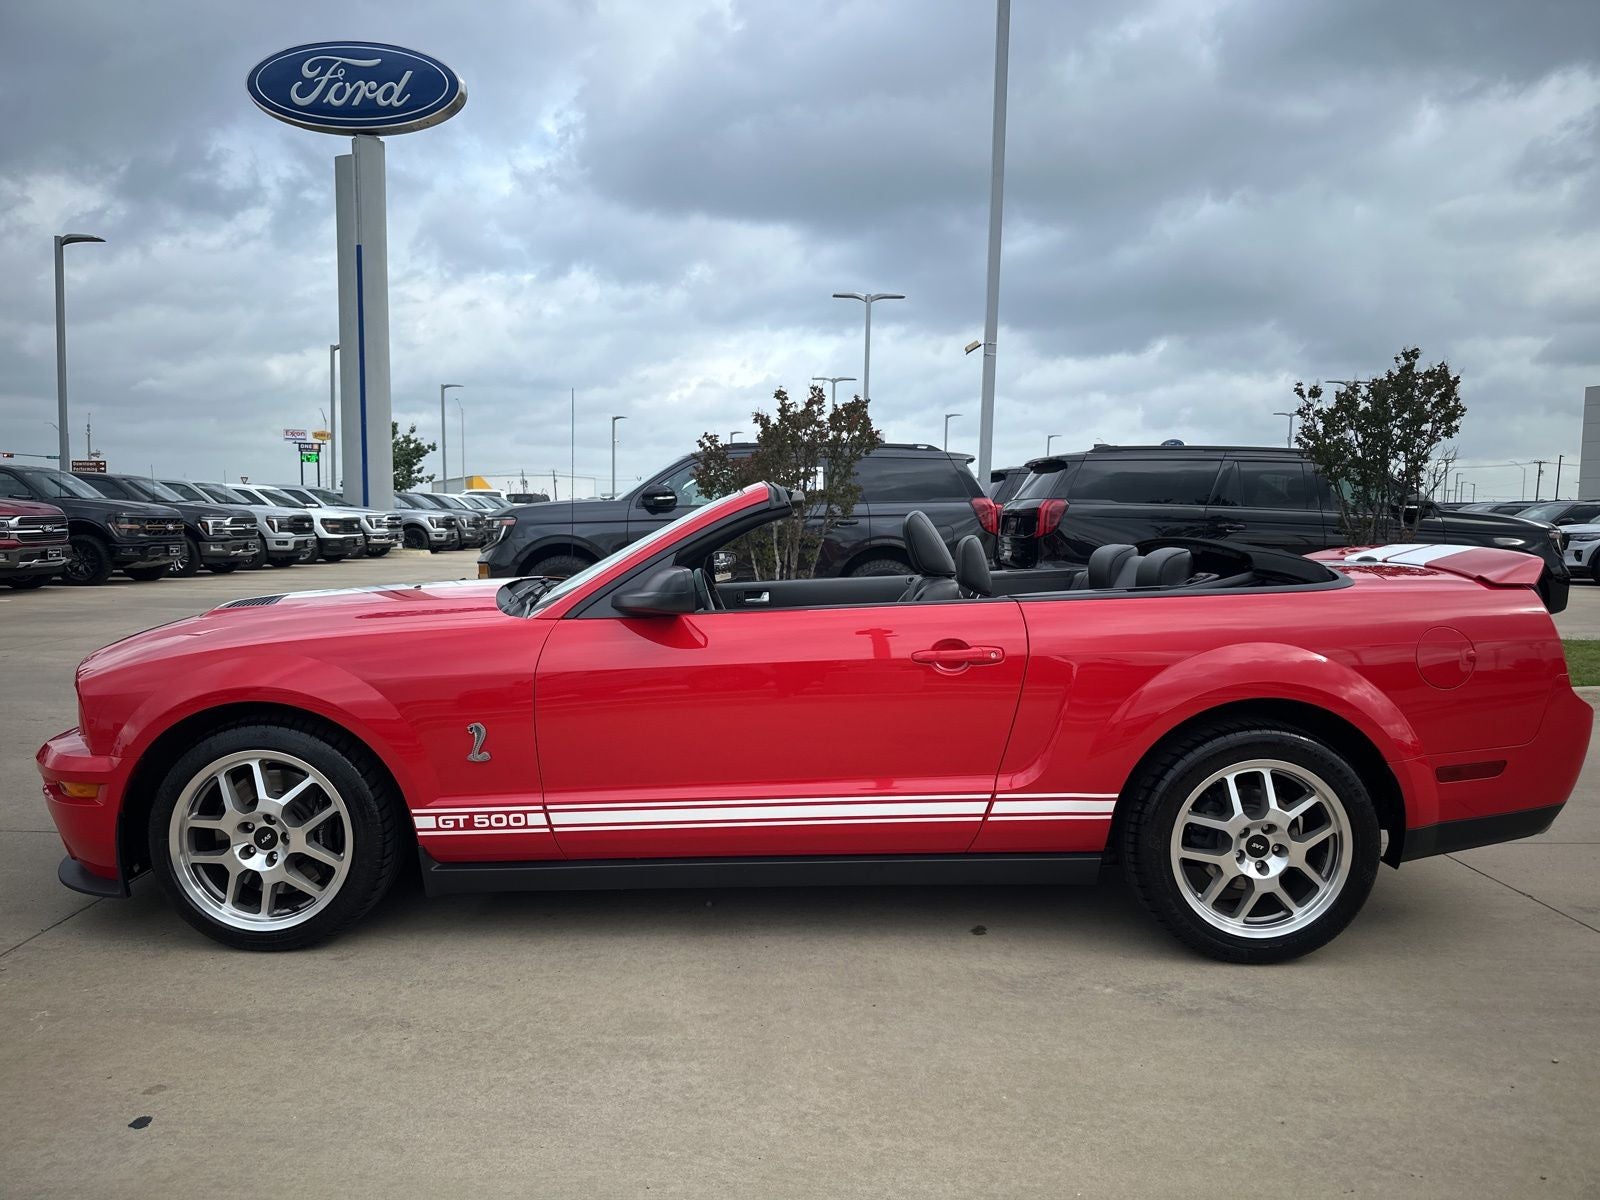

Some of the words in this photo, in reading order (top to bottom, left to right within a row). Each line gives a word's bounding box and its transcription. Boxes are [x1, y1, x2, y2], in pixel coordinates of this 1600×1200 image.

[290, 55, 413, 107] Ford
[285, 430, 305, 438] Exxon
[437, 814, 469, 829] GT
[473, 813, 526, 828] 500
[1251, 842, 1264, 850] SVT
